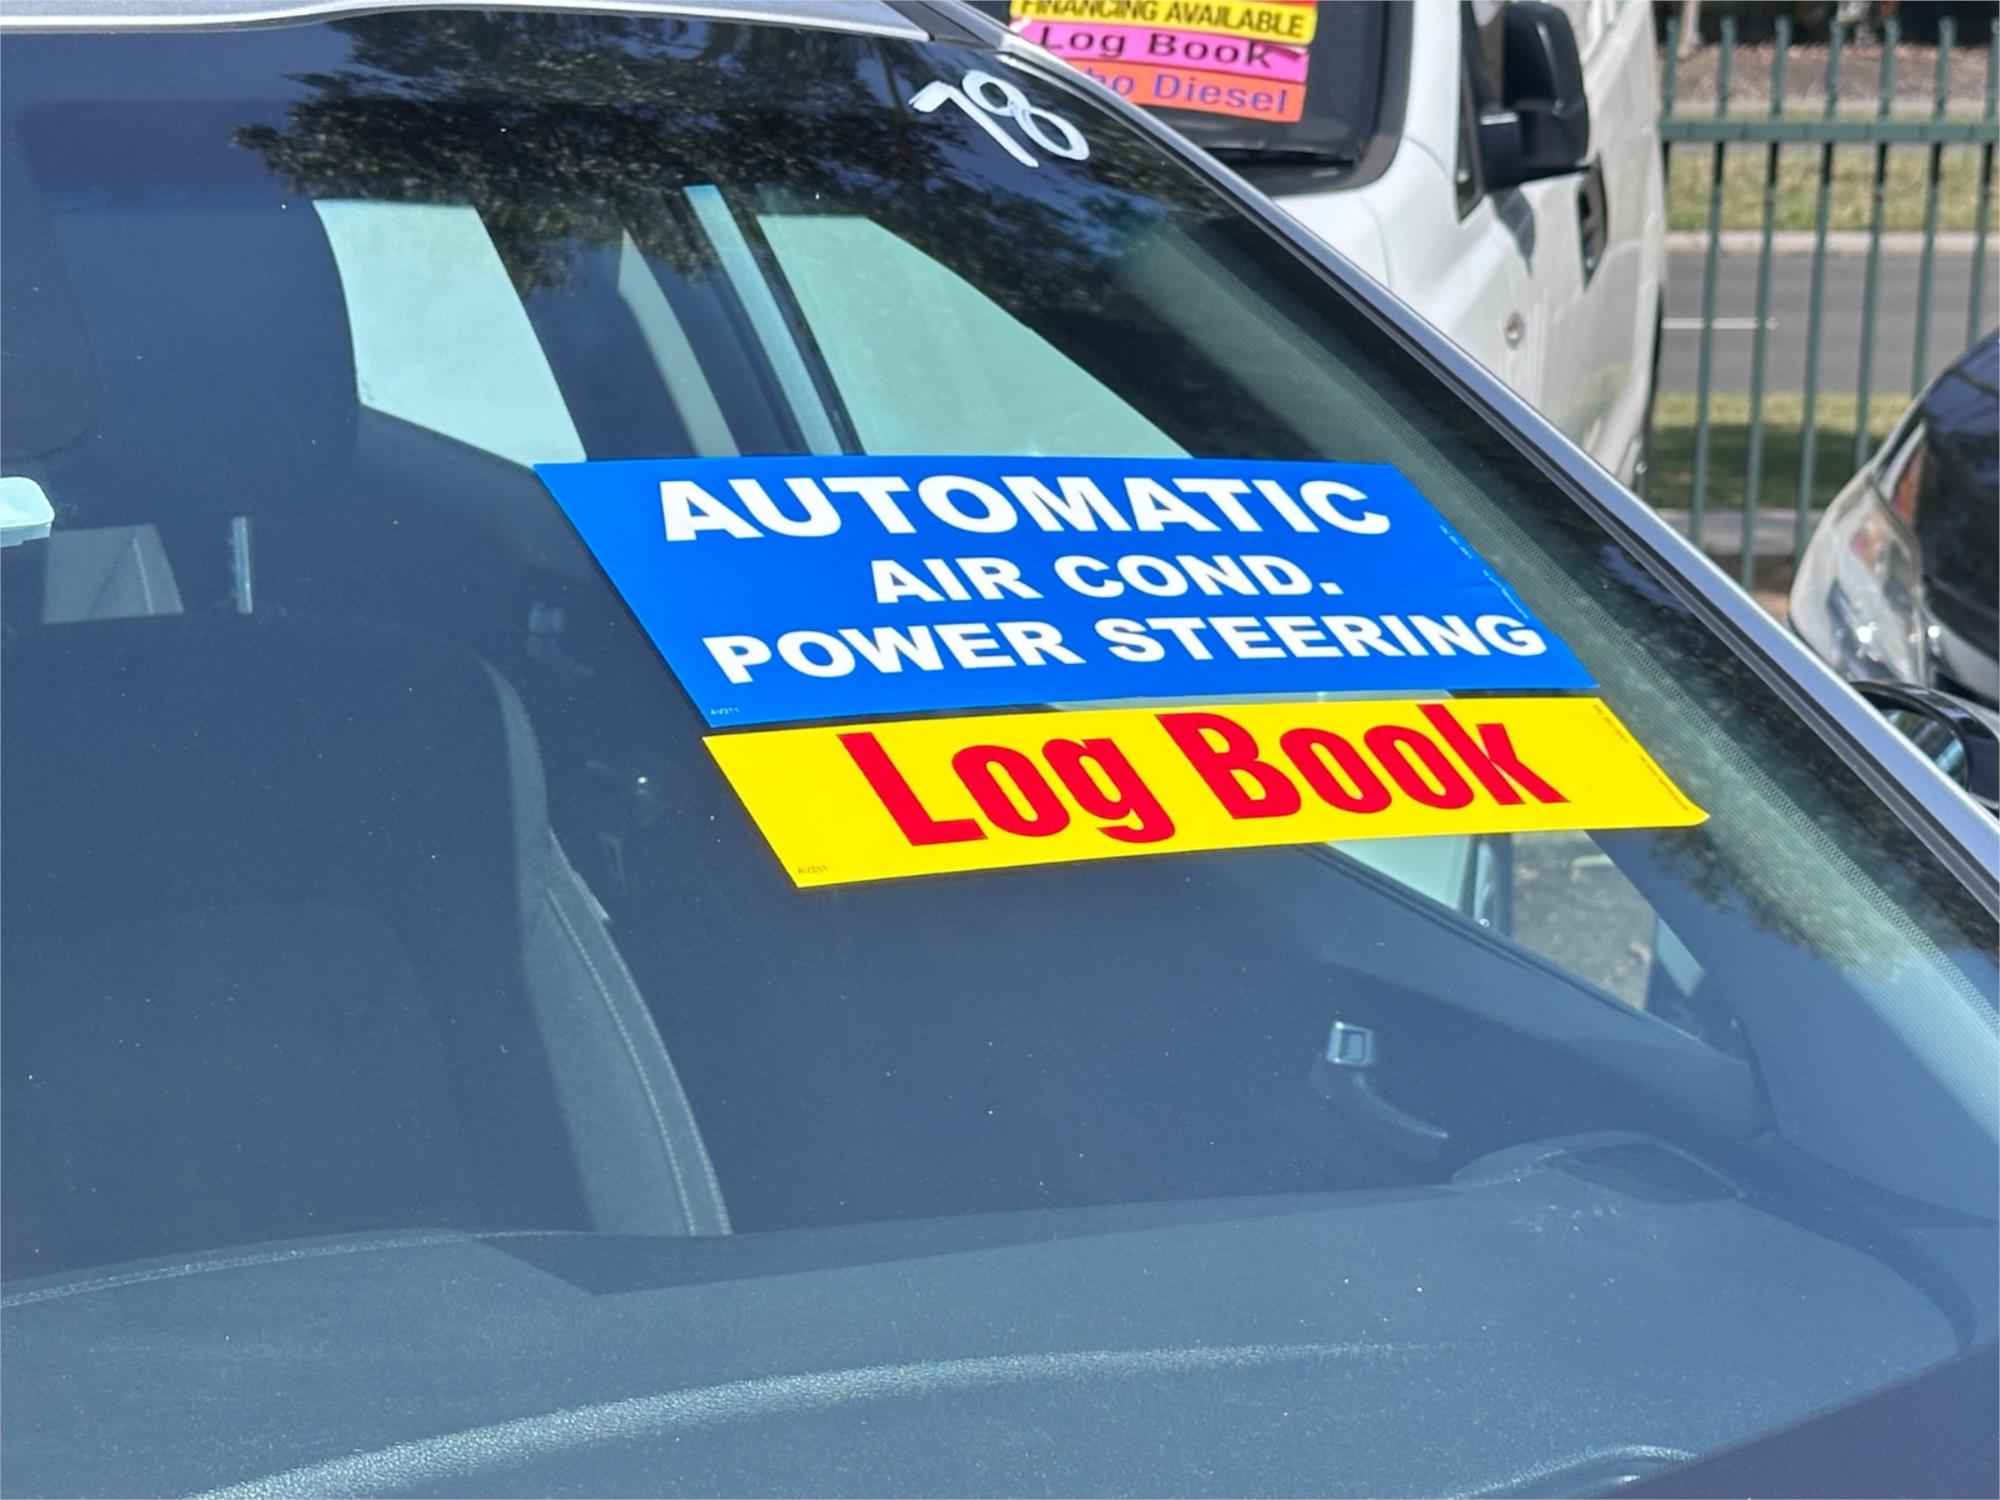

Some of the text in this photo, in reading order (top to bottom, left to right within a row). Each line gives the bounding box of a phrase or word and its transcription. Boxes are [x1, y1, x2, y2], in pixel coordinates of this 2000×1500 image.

[1020, 0, 1305, 38] FINANCING AVAILABLE
[1040, 26, 1271, 69] Log Book
[908, 70, 1090, 168] 78
[1153, 73, 1288, 114] Diesel
[660, 475, 1390, 541] AUTOMATIC
[871, 555, 1343, 603] AIR COND.
[702, 614, 1547, 684] POWER STEERING
[837, 731, 1175, 845] Log
[1156, 703, 1571, 820] Book
